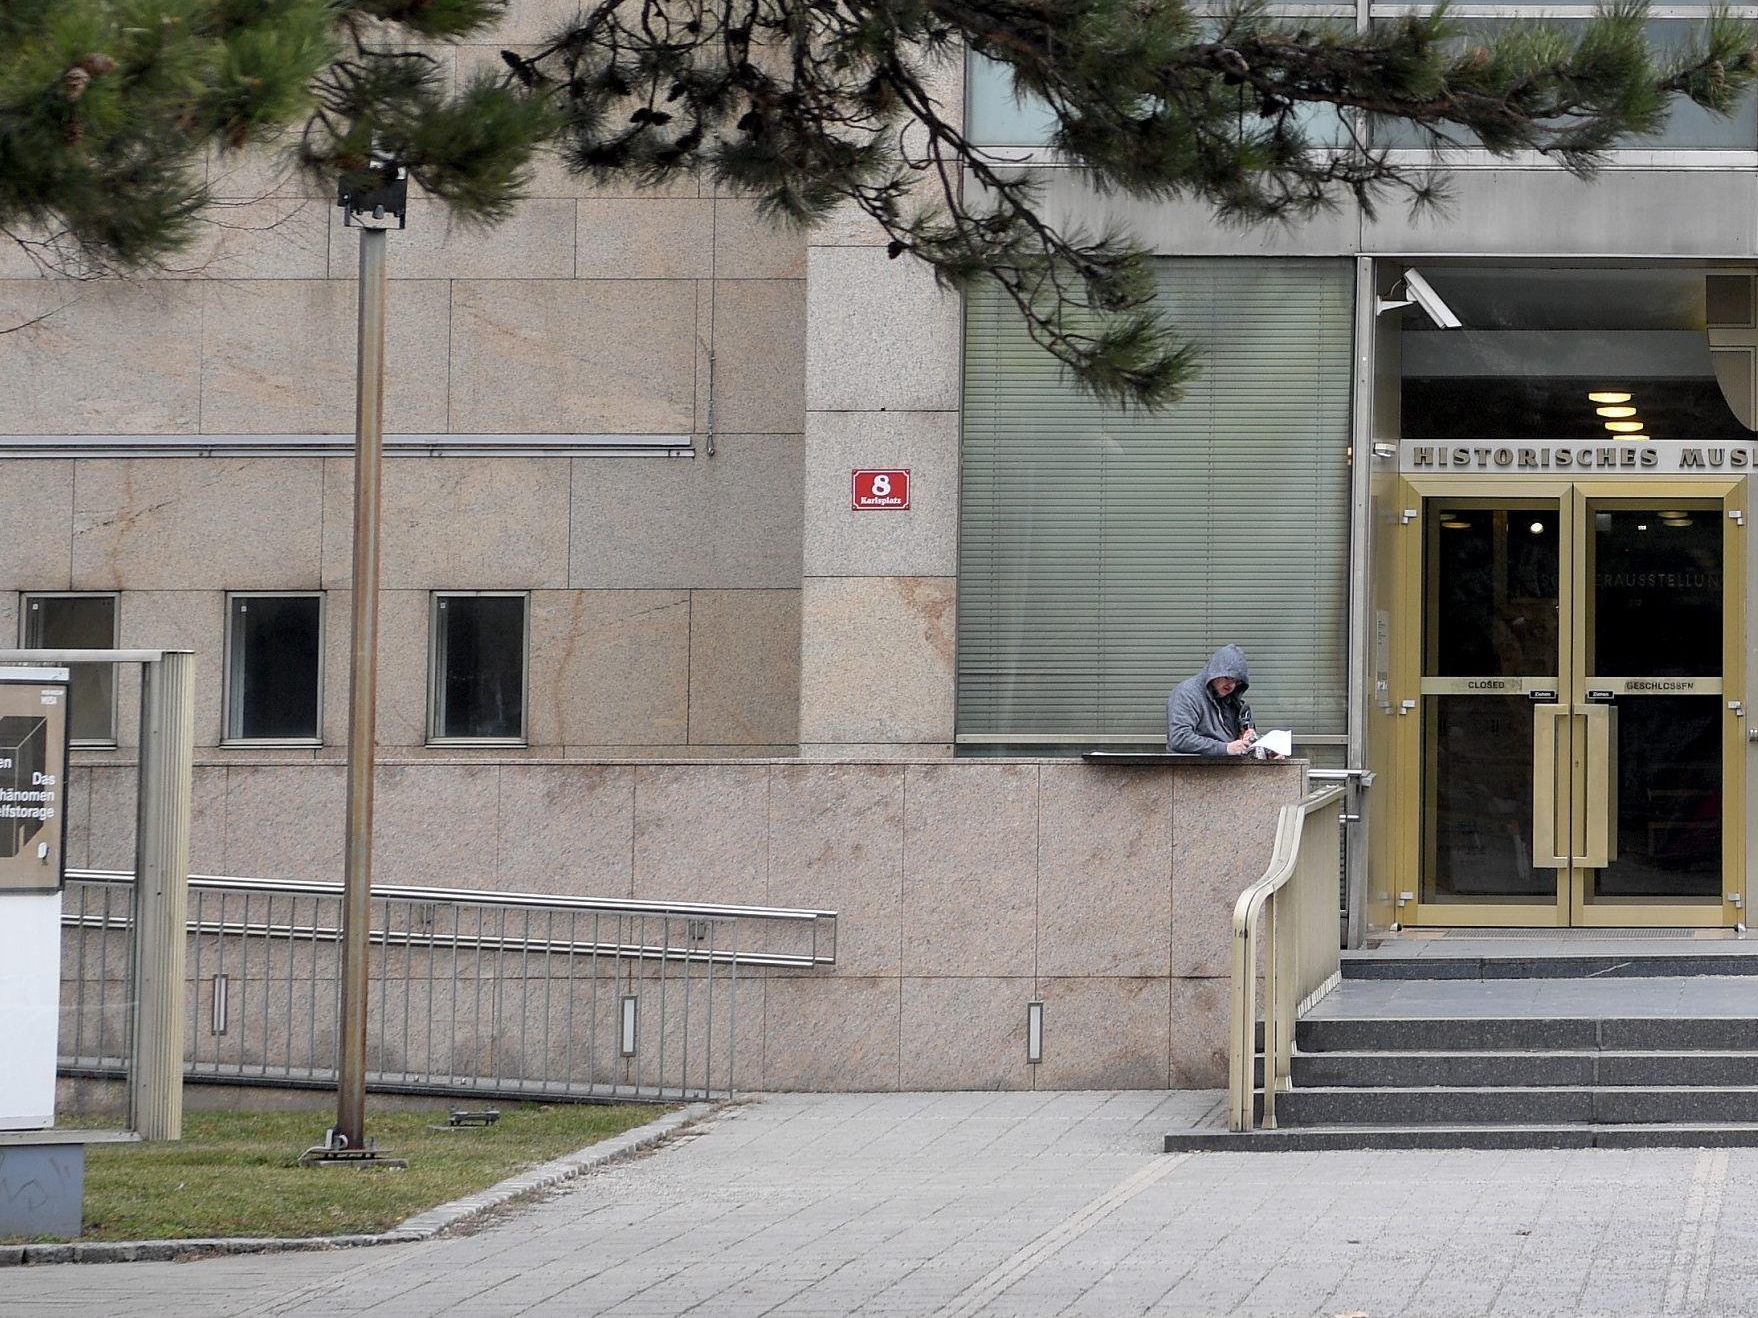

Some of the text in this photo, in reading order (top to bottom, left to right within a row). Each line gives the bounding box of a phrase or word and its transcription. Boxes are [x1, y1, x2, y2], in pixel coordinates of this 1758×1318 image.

[1413, 447, 1659, 466] HISTORISCHES
[871, 474, 891, 496] 8
[861, 497, 901, 505] Karlsplatz
[1468, 680, 1505, 689] CLOSED
[32, 771, 56, 785] Das
[0, 788, 55, 801] hänomen
[0, 804, 55, 820] lfstorage
